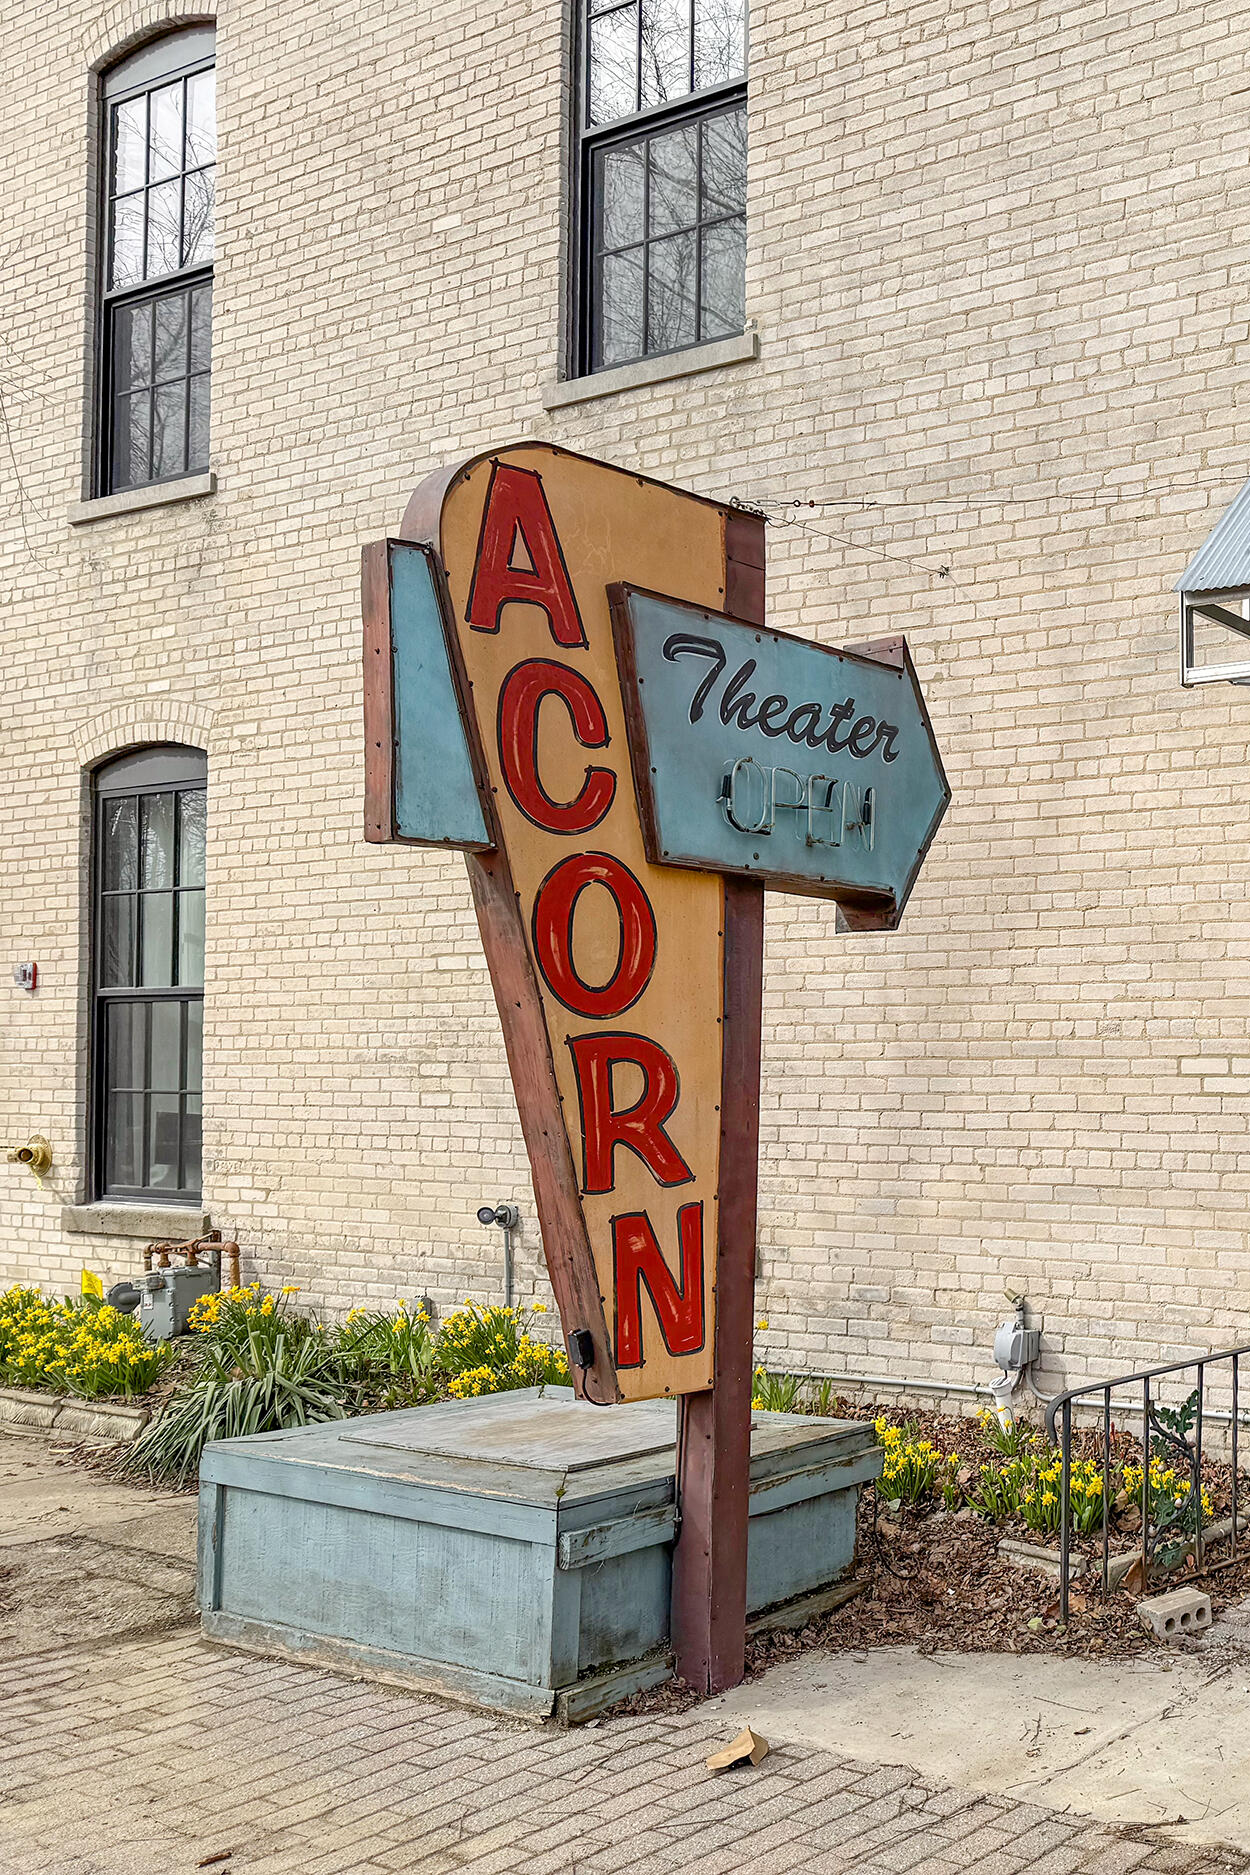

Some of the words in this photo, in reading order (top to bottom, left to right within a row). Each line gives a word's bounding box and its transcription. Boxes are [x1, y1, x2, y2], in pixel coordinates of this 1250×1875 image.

[662, 633, 900, 764] Theater
[728, 756, 877, 853] OPEN
[465, 458, 705, 1369] ACORN
